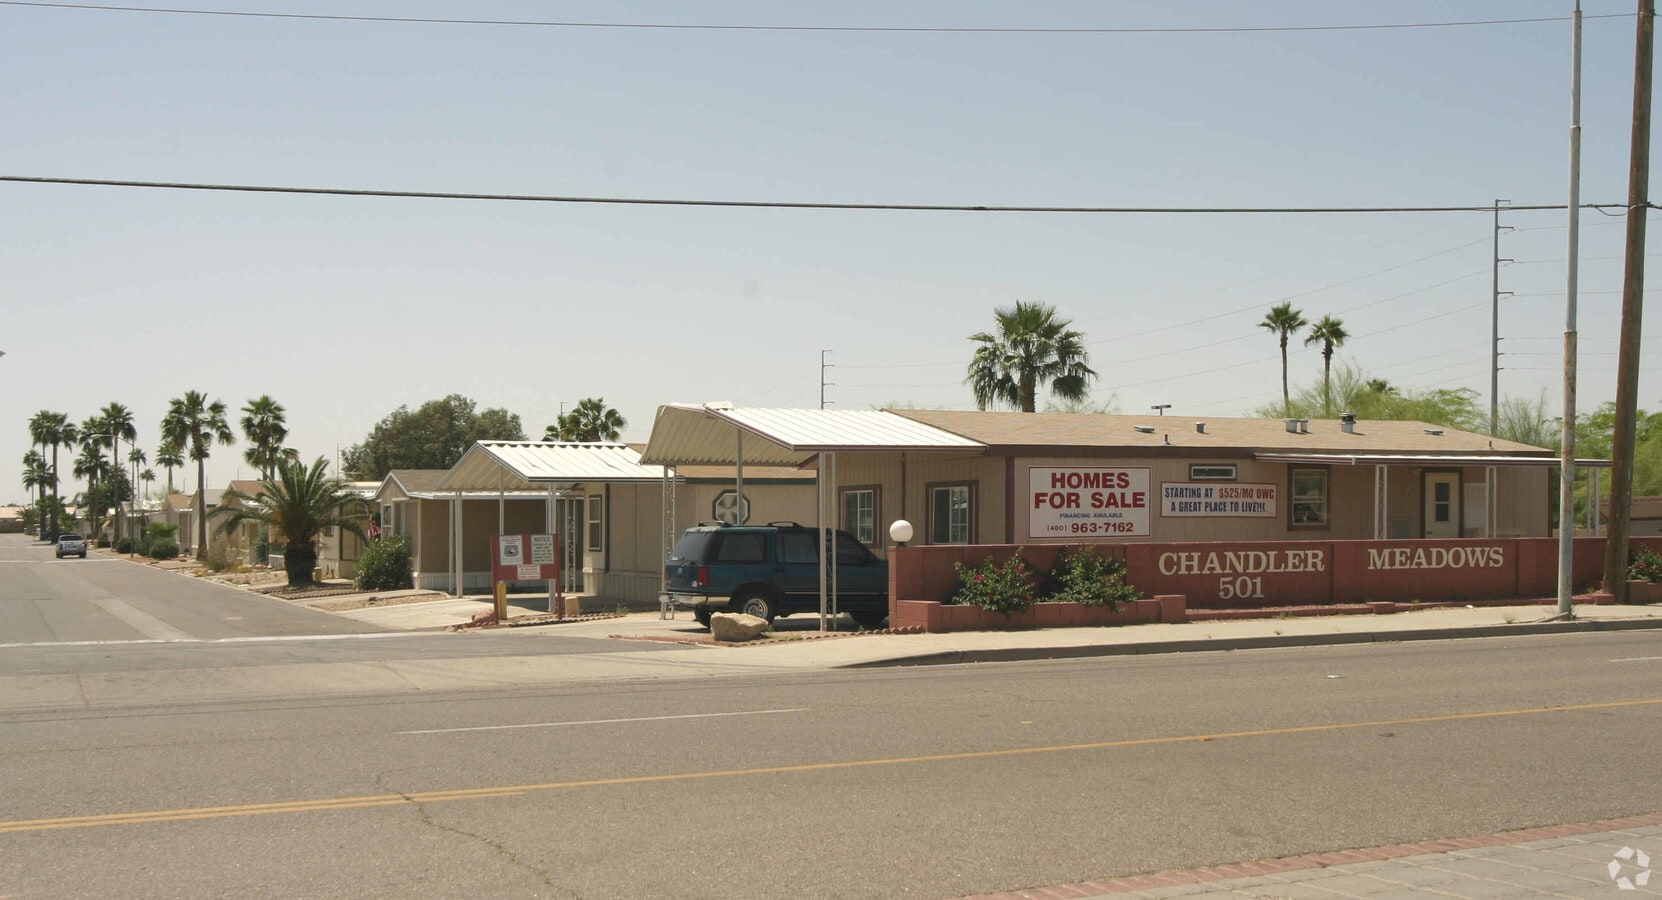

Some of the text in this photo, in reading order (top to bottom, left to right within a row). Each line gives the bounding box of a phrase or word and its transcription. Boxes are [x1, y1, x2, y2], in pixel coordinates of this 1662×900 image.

[1051, 472, 1130, 489] HOMES
[1034, 492, 1145, 509] FOR SALE
[1164, 487, 1274, 499] STARTING AT $525/MO OWC
[1171, 502, 1266, 512] A GREAT PLACE TO LIVE!!!
[1071, 522, 1134, 533] 963-7162
[1158, 547, 1504, 576] CHANDLER MEADOWS
[1218, 576, 1265, 599] 501
